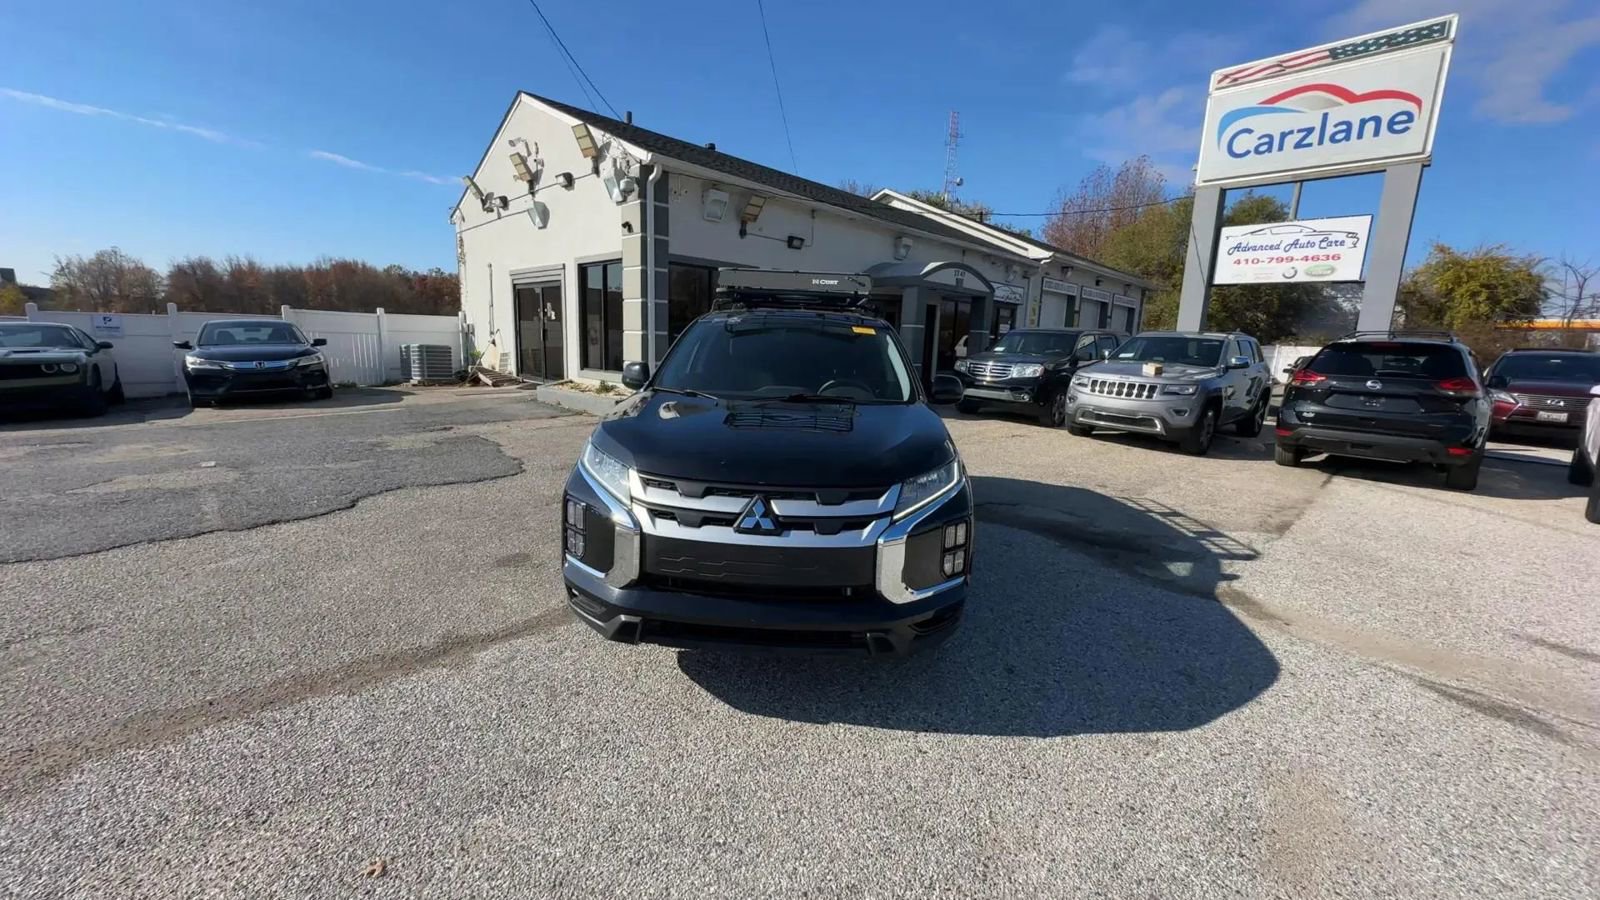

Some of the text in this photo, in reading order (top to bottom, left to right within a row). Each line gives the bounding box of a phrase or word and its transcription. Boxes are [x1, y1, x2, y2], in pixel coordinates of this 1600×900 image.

[1226, 110, 1415, 159] Carzlane
[1227, 236, 1346, 256] Advanced Auto Care
[1233, 253, 1342, 265] 410-799-4636
